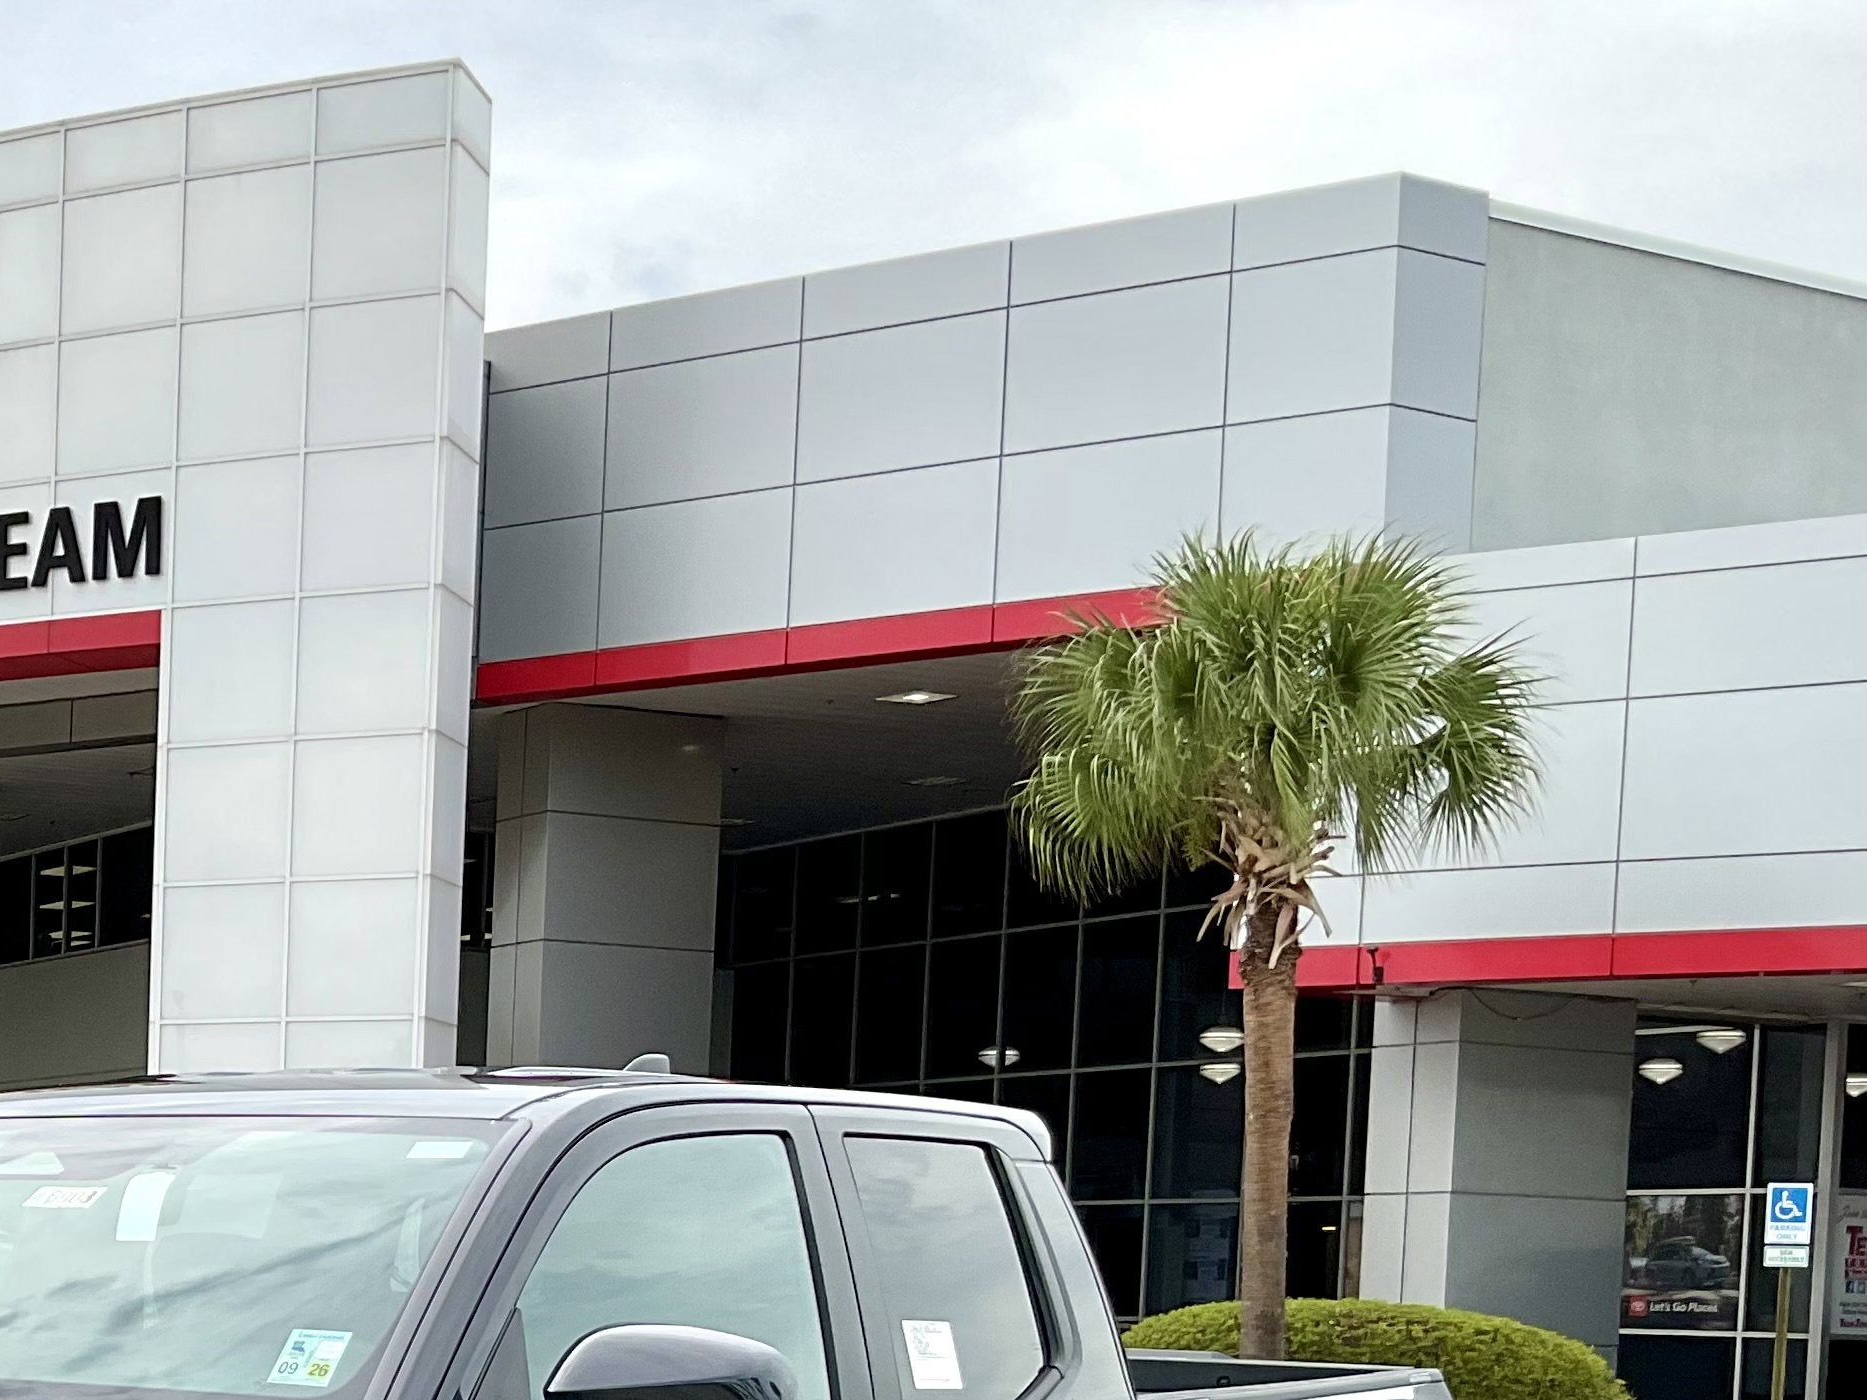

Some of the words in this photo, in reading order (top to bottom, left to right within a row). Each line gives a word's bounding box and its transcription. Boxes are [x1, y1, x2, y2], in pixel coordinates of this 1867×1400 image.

[1649, 1301, 1671, 1312] Let's
[1672, 1301, 1687, 1312] Go
[277, 1361, 299, 1375] 09
[308, 1362, 331, 1377] 26
